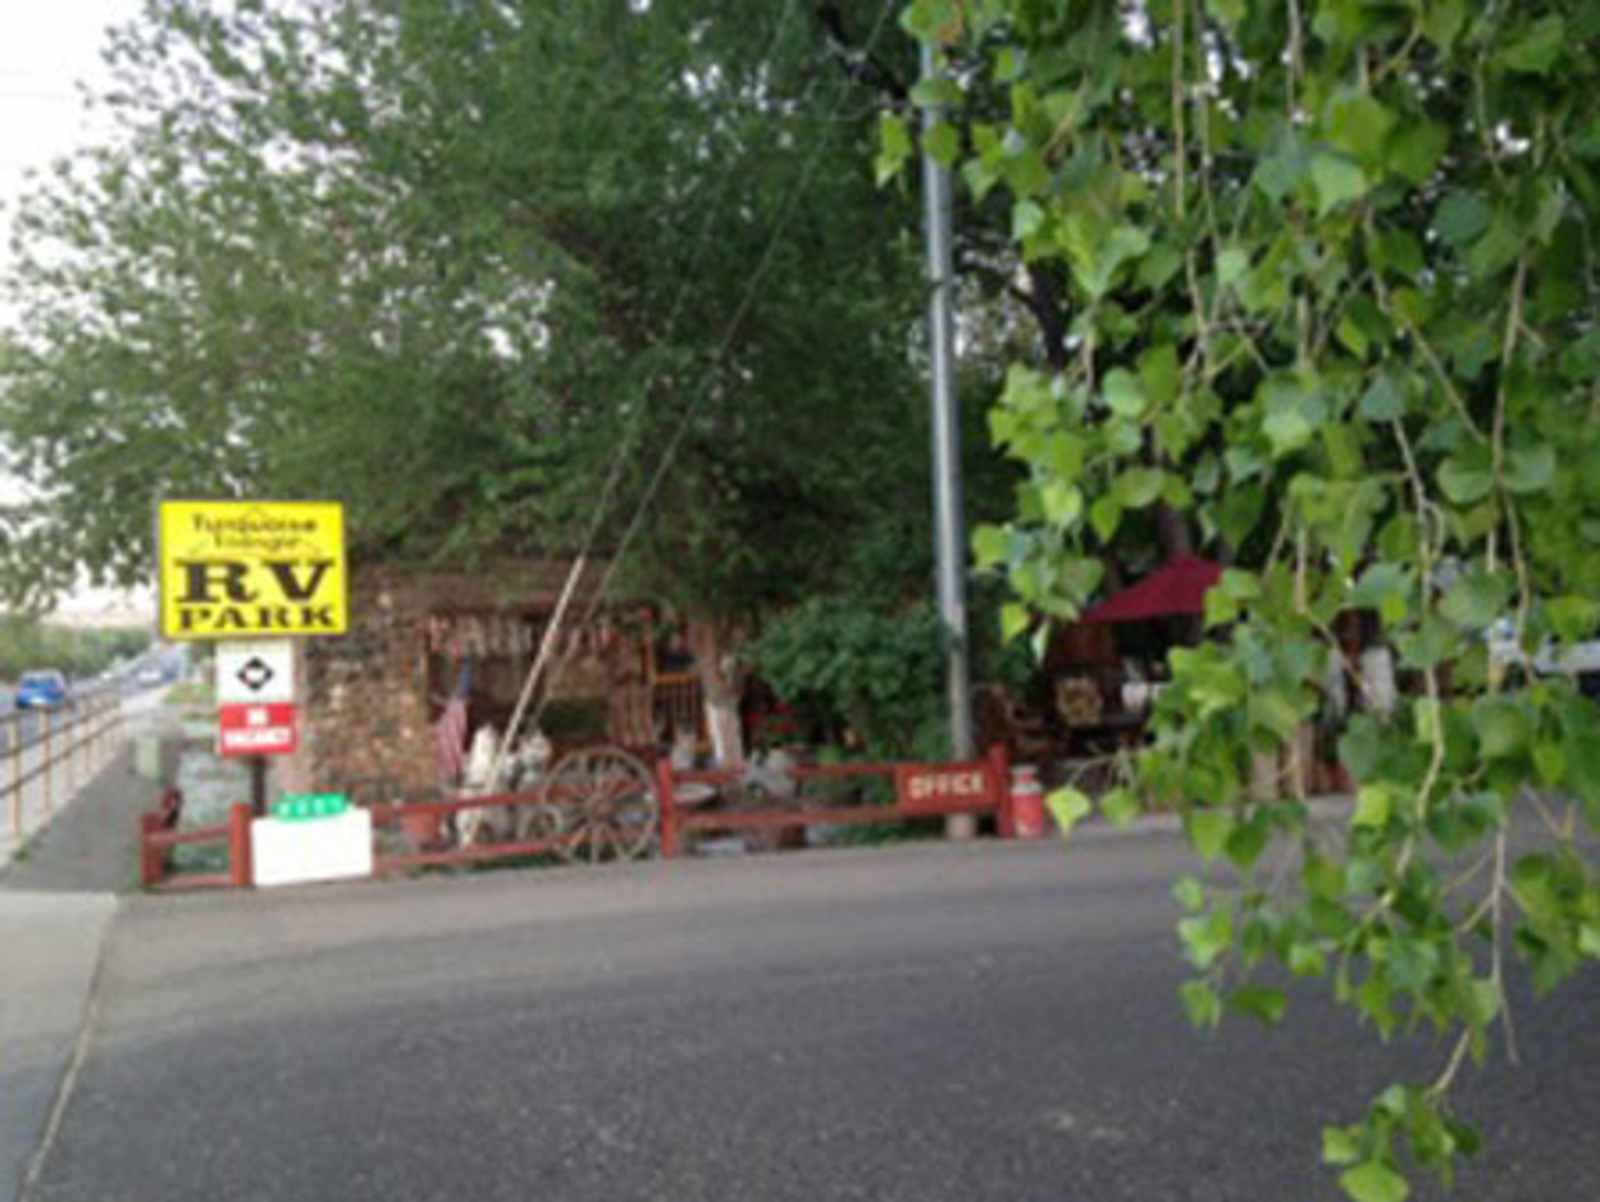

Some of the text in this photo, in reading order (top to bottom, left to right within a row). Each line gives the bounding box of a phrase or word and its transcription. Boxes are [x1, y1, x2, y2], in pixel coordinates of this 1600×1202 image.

[174, 558, 335, 603] RV
[178, 605, 334, 631] PARK
[907, 770, 985, 800] OFFICE
